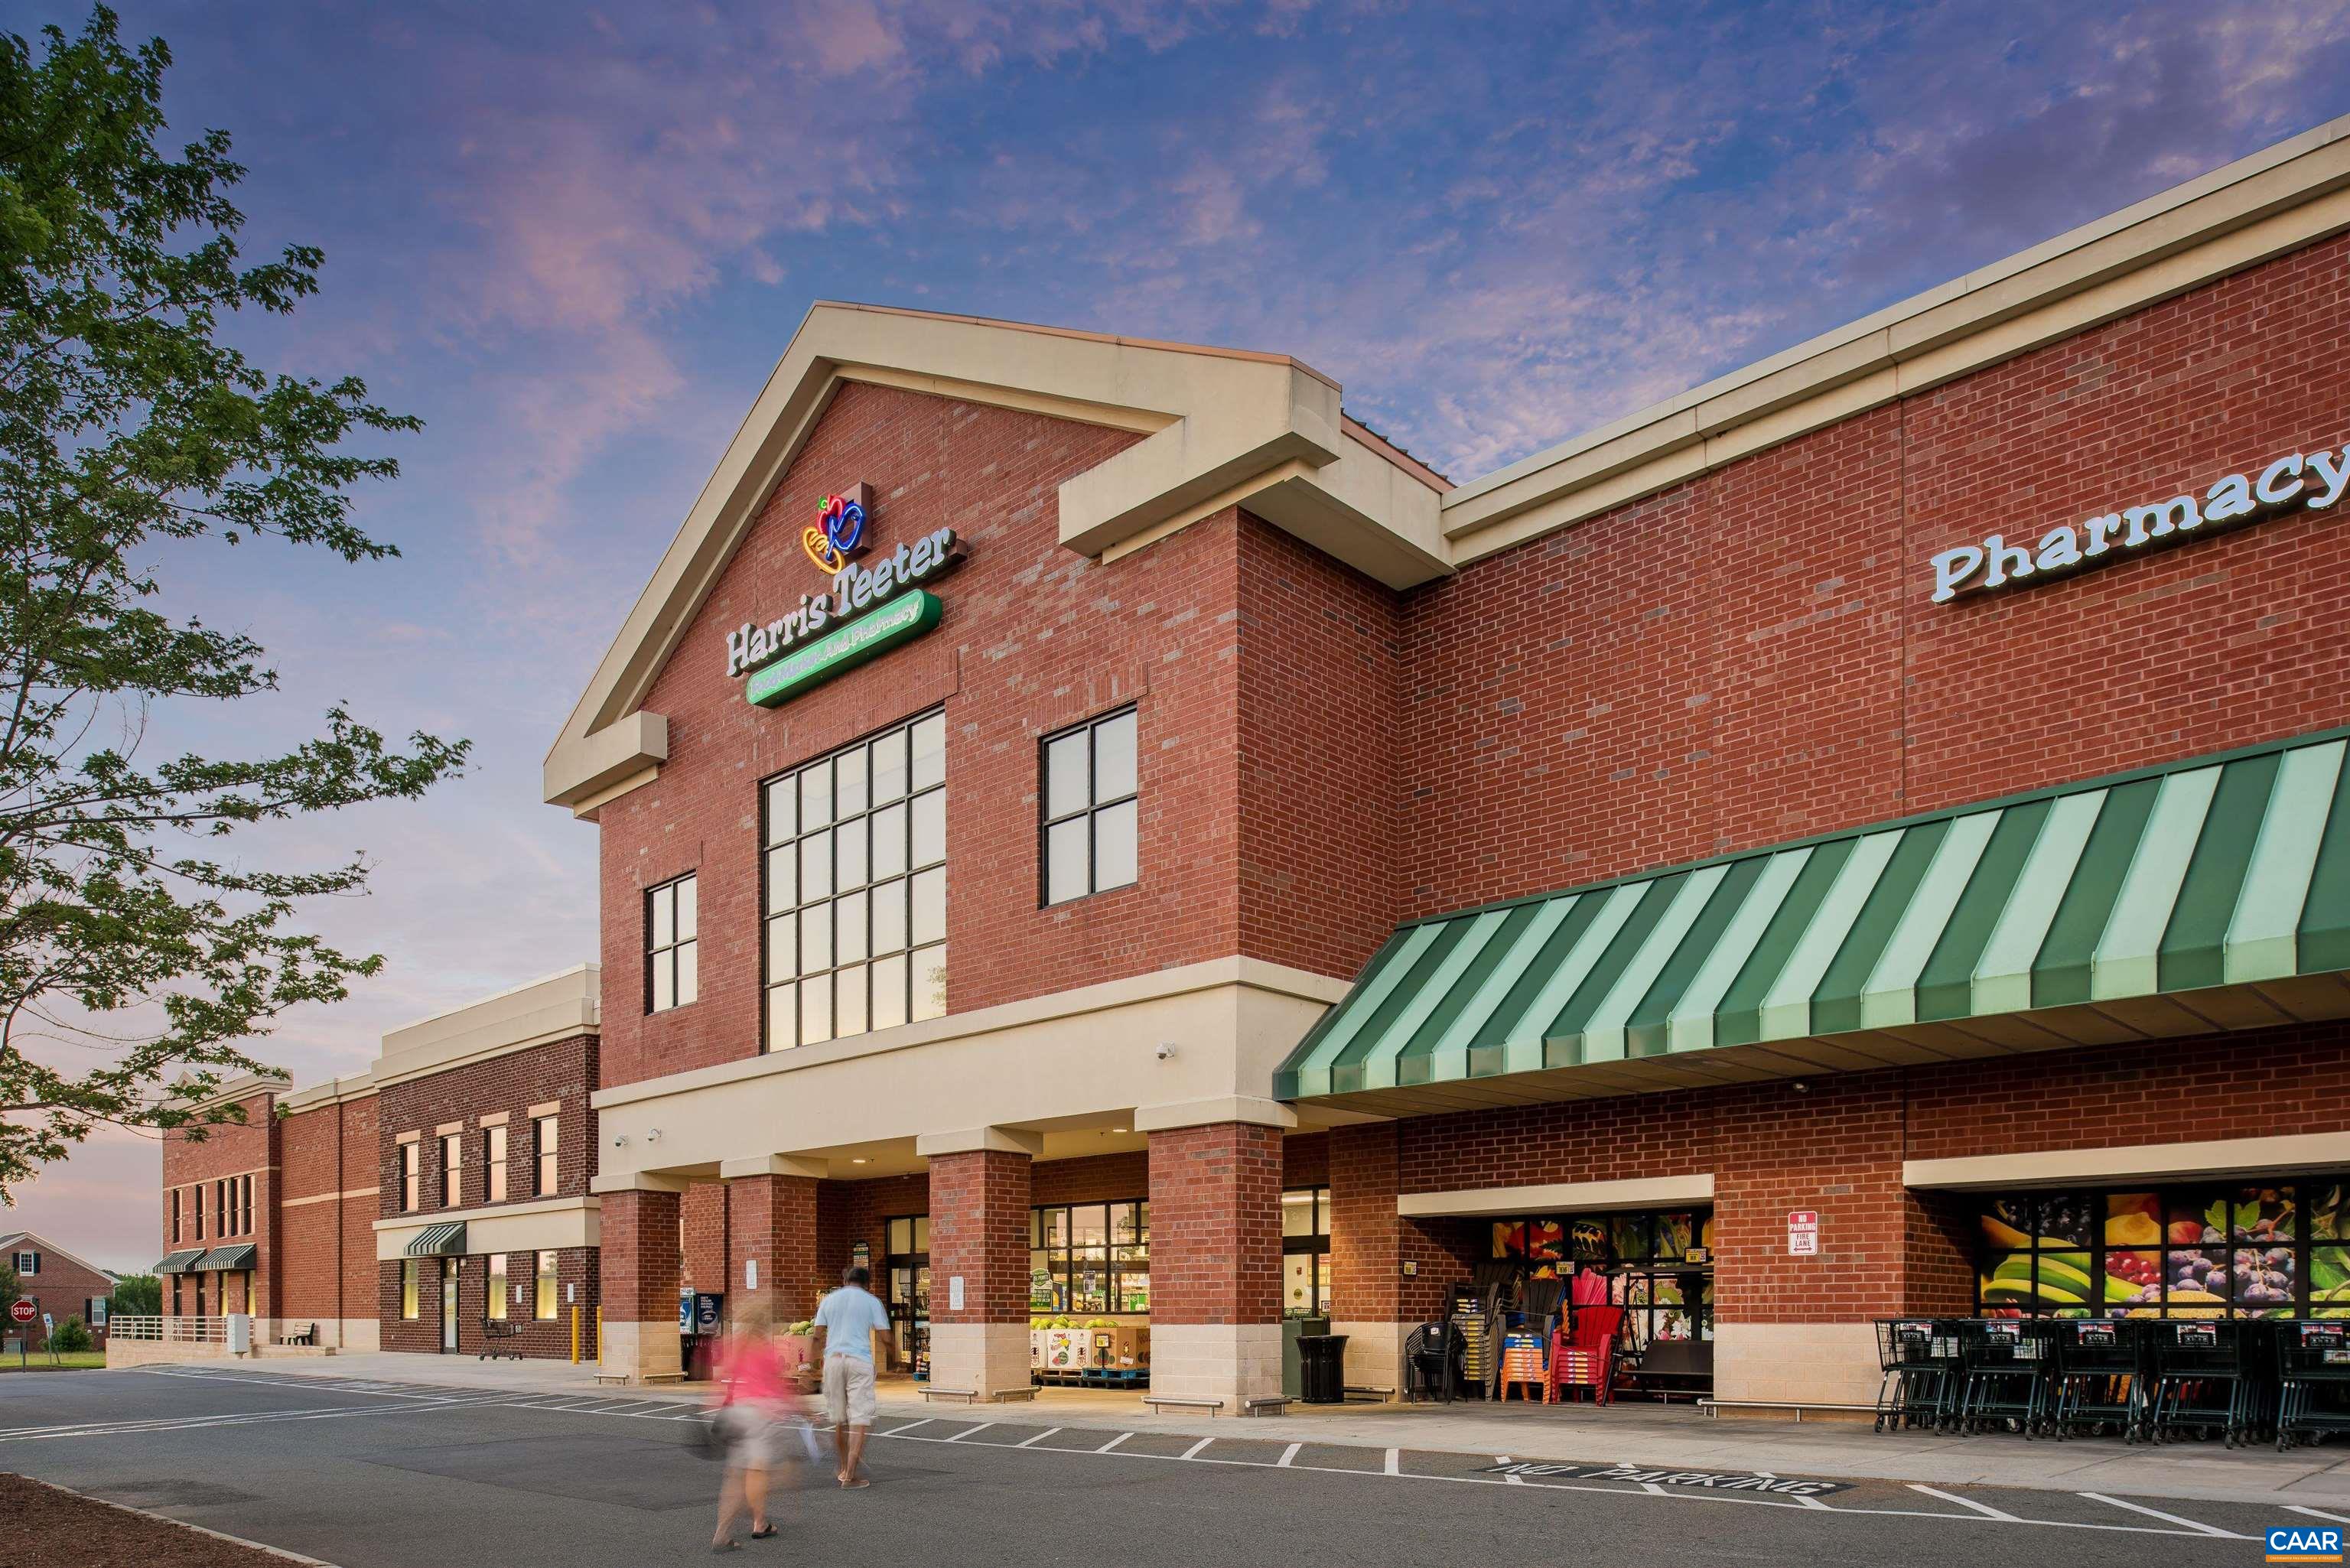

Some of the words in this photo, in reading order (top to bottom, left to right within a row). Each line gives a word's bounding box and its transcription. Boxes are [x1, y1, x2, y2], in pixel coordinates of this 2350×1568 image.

[1930, 444, 2350, 604] Pharmacy
[726, 594, 828, 677] Harris
[832, 526, 951, 616] Teeter
[1790, 1222, 1816, 1231] PARKING
[1798, 1214, 1807, 1223] NO
[14, 1307, 35, 1316] STOP
[1486, 1462, 1580, 1476] NO
[1578, 1467, 1837, 1495] PARKING
